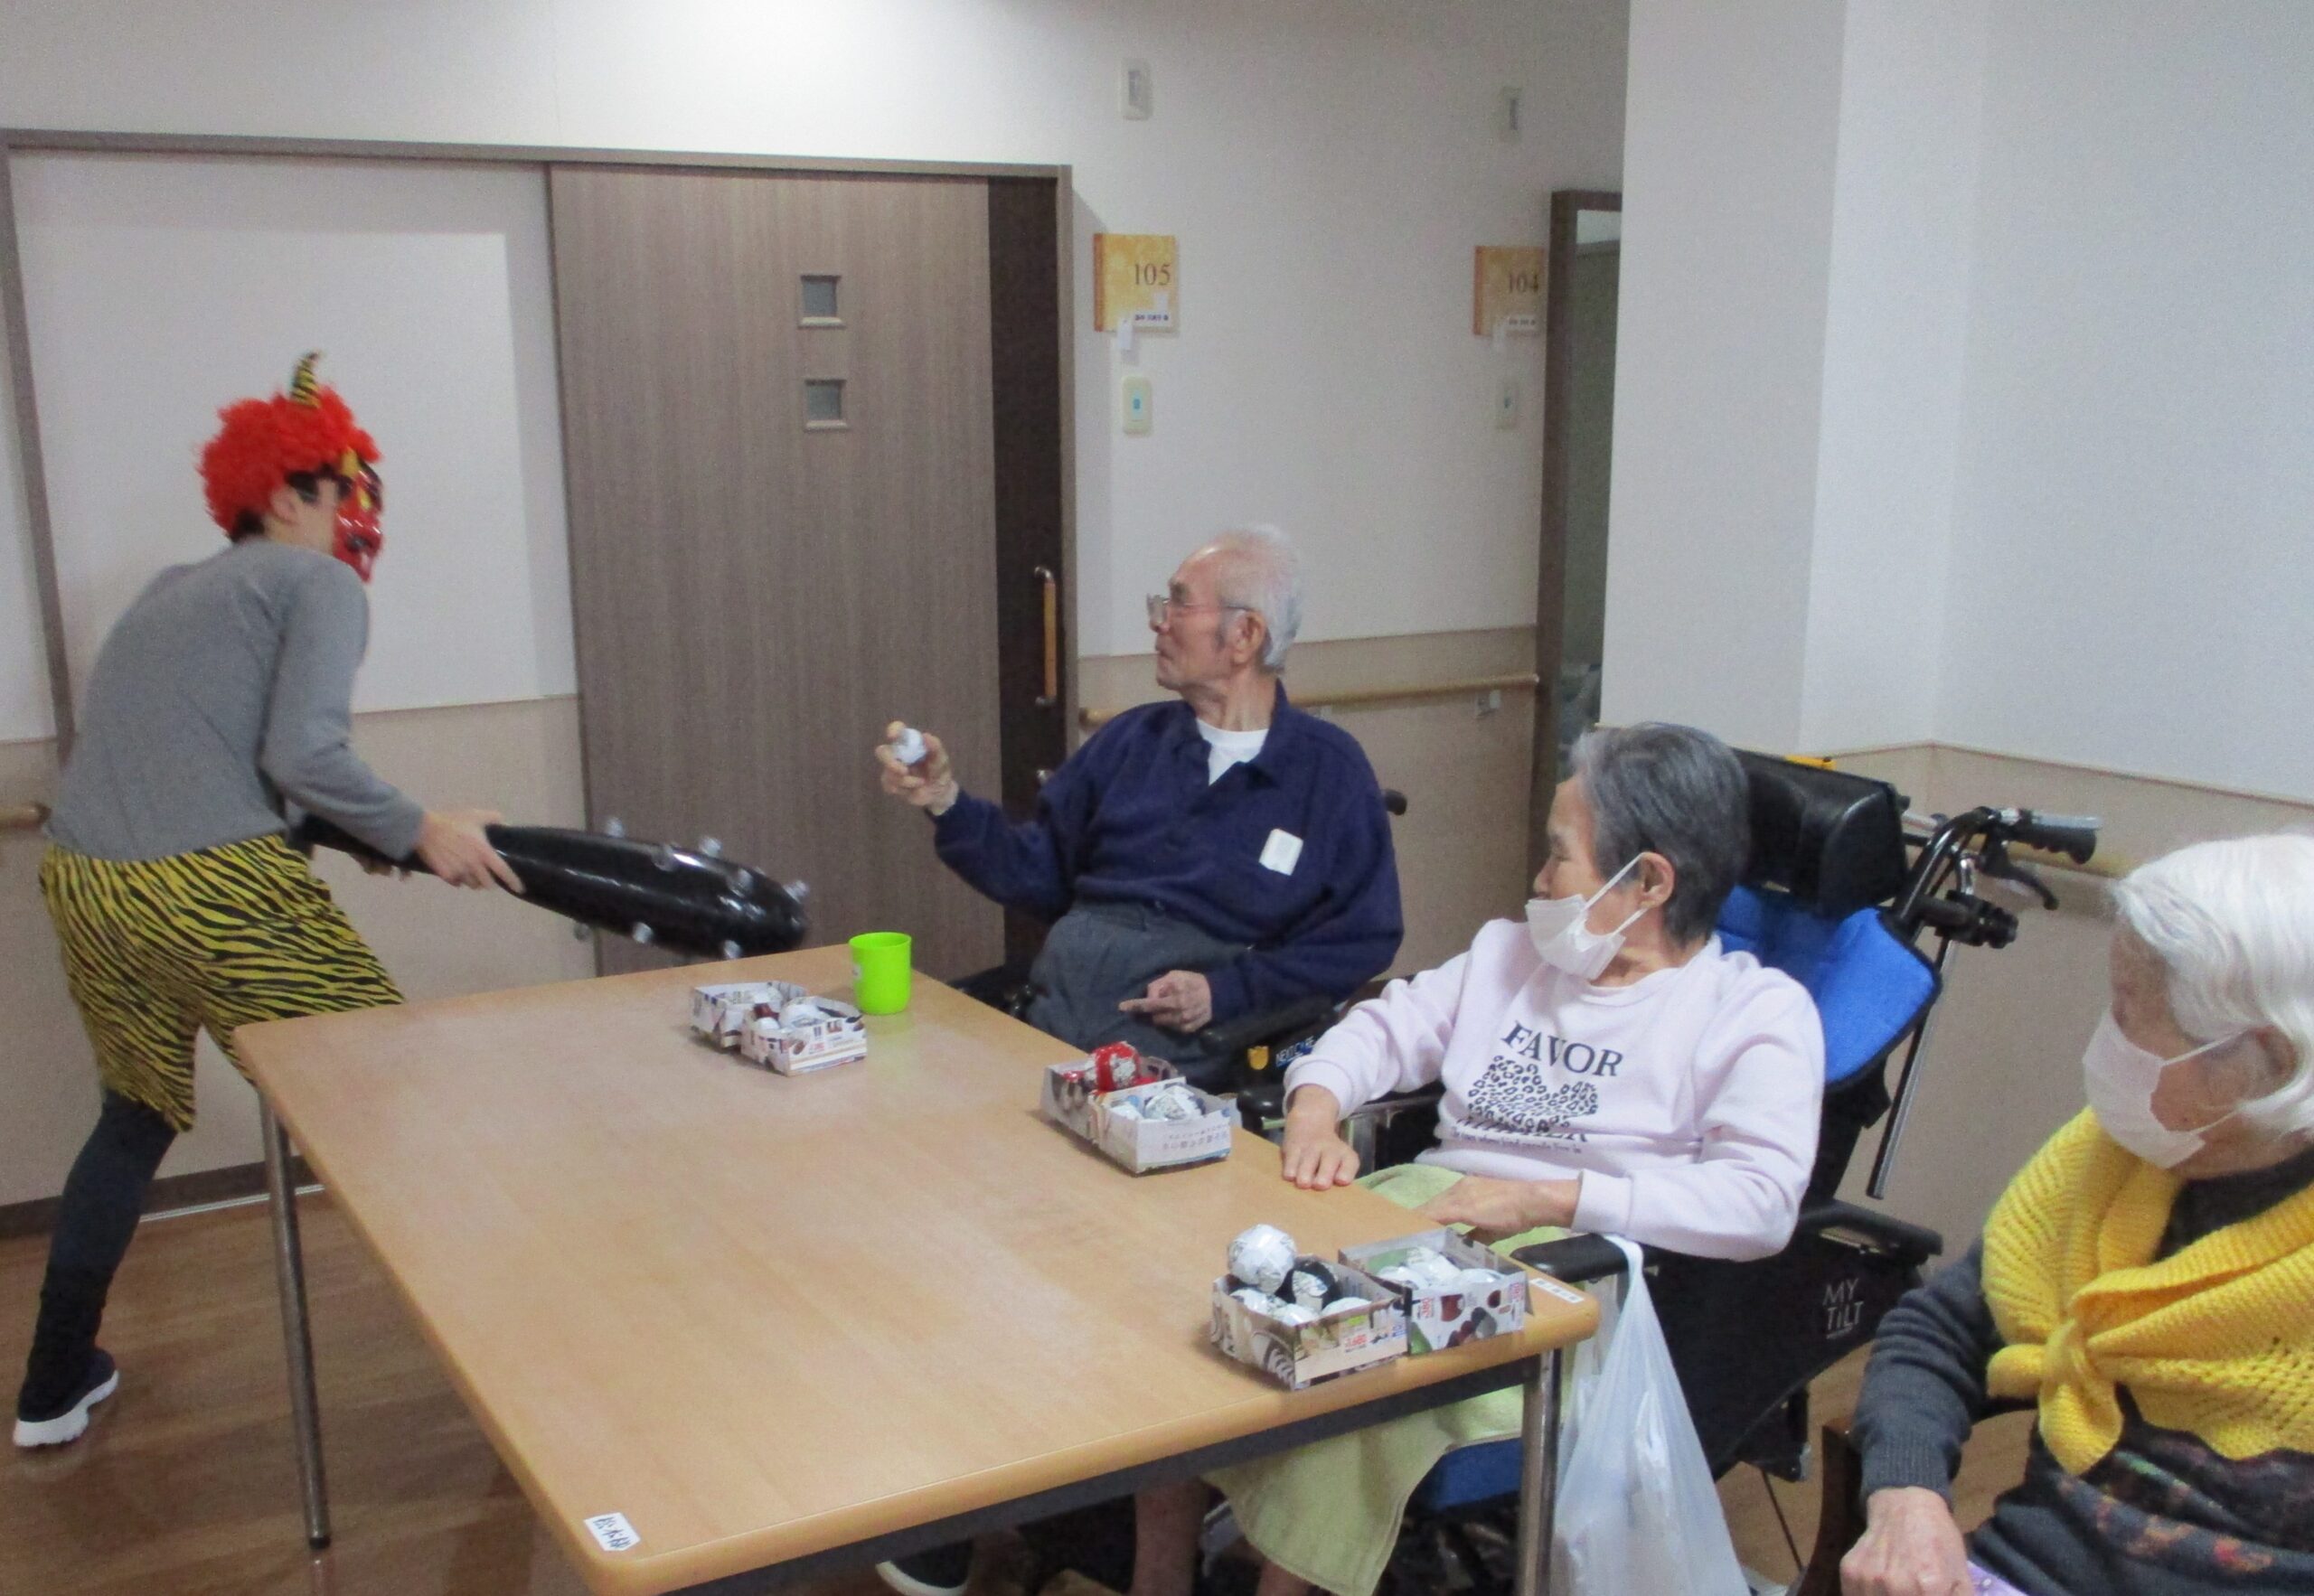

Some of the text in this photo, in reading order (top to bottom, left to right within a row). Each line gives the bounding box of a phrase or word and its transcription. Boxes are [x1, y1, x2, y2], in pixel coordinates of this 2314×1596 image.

[1134, 263, 1171, 286] 105
[1509, 274, 1538, 293] 104
[1500, 1019, 1623, 1076] FAVOR
[1822, 1277, 1859, 1306] MY
